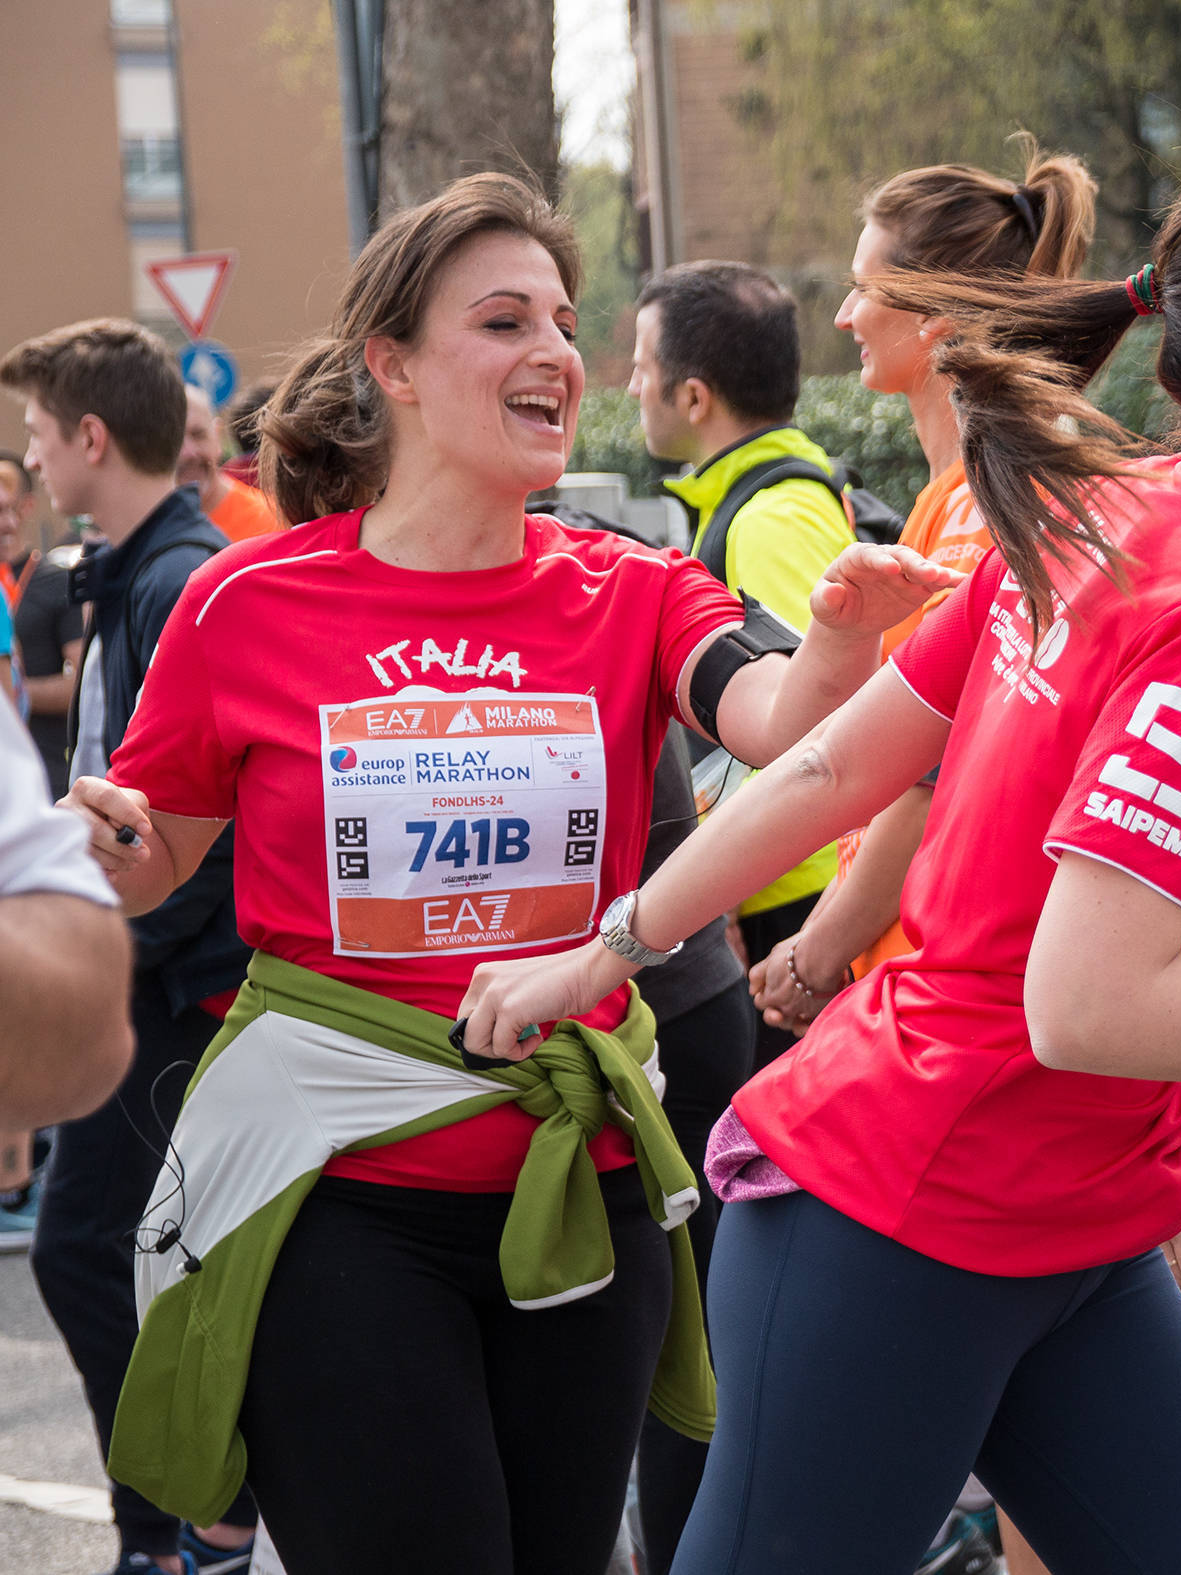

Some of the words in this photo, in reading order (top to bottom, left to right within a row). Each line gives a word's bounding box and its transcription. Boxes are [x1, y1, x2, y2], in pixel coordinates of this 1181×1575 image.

[365, 637, 528, 688] ITALIA
[366, 708, 425, 730] EA7
[485, 706, 555, 720] MILANO
[486, 718, 558, 729] MARATHON
[415, 750, 490, 768] RELAY
[564, 751, 583, 760] LILT
[361, 758, 405, 772] europ
[331, 773, 407, 787] assistance
[416, 766, 530, 784] MARATHON
[432, 795, 504, 808] FONDLHS-24
[405, 817, 531, 873] 741B
[423, 894, 511, 935] EA7
[425, 932, 468, 947] EMPORIO
[480, 929, 516, 943] ARMANI
